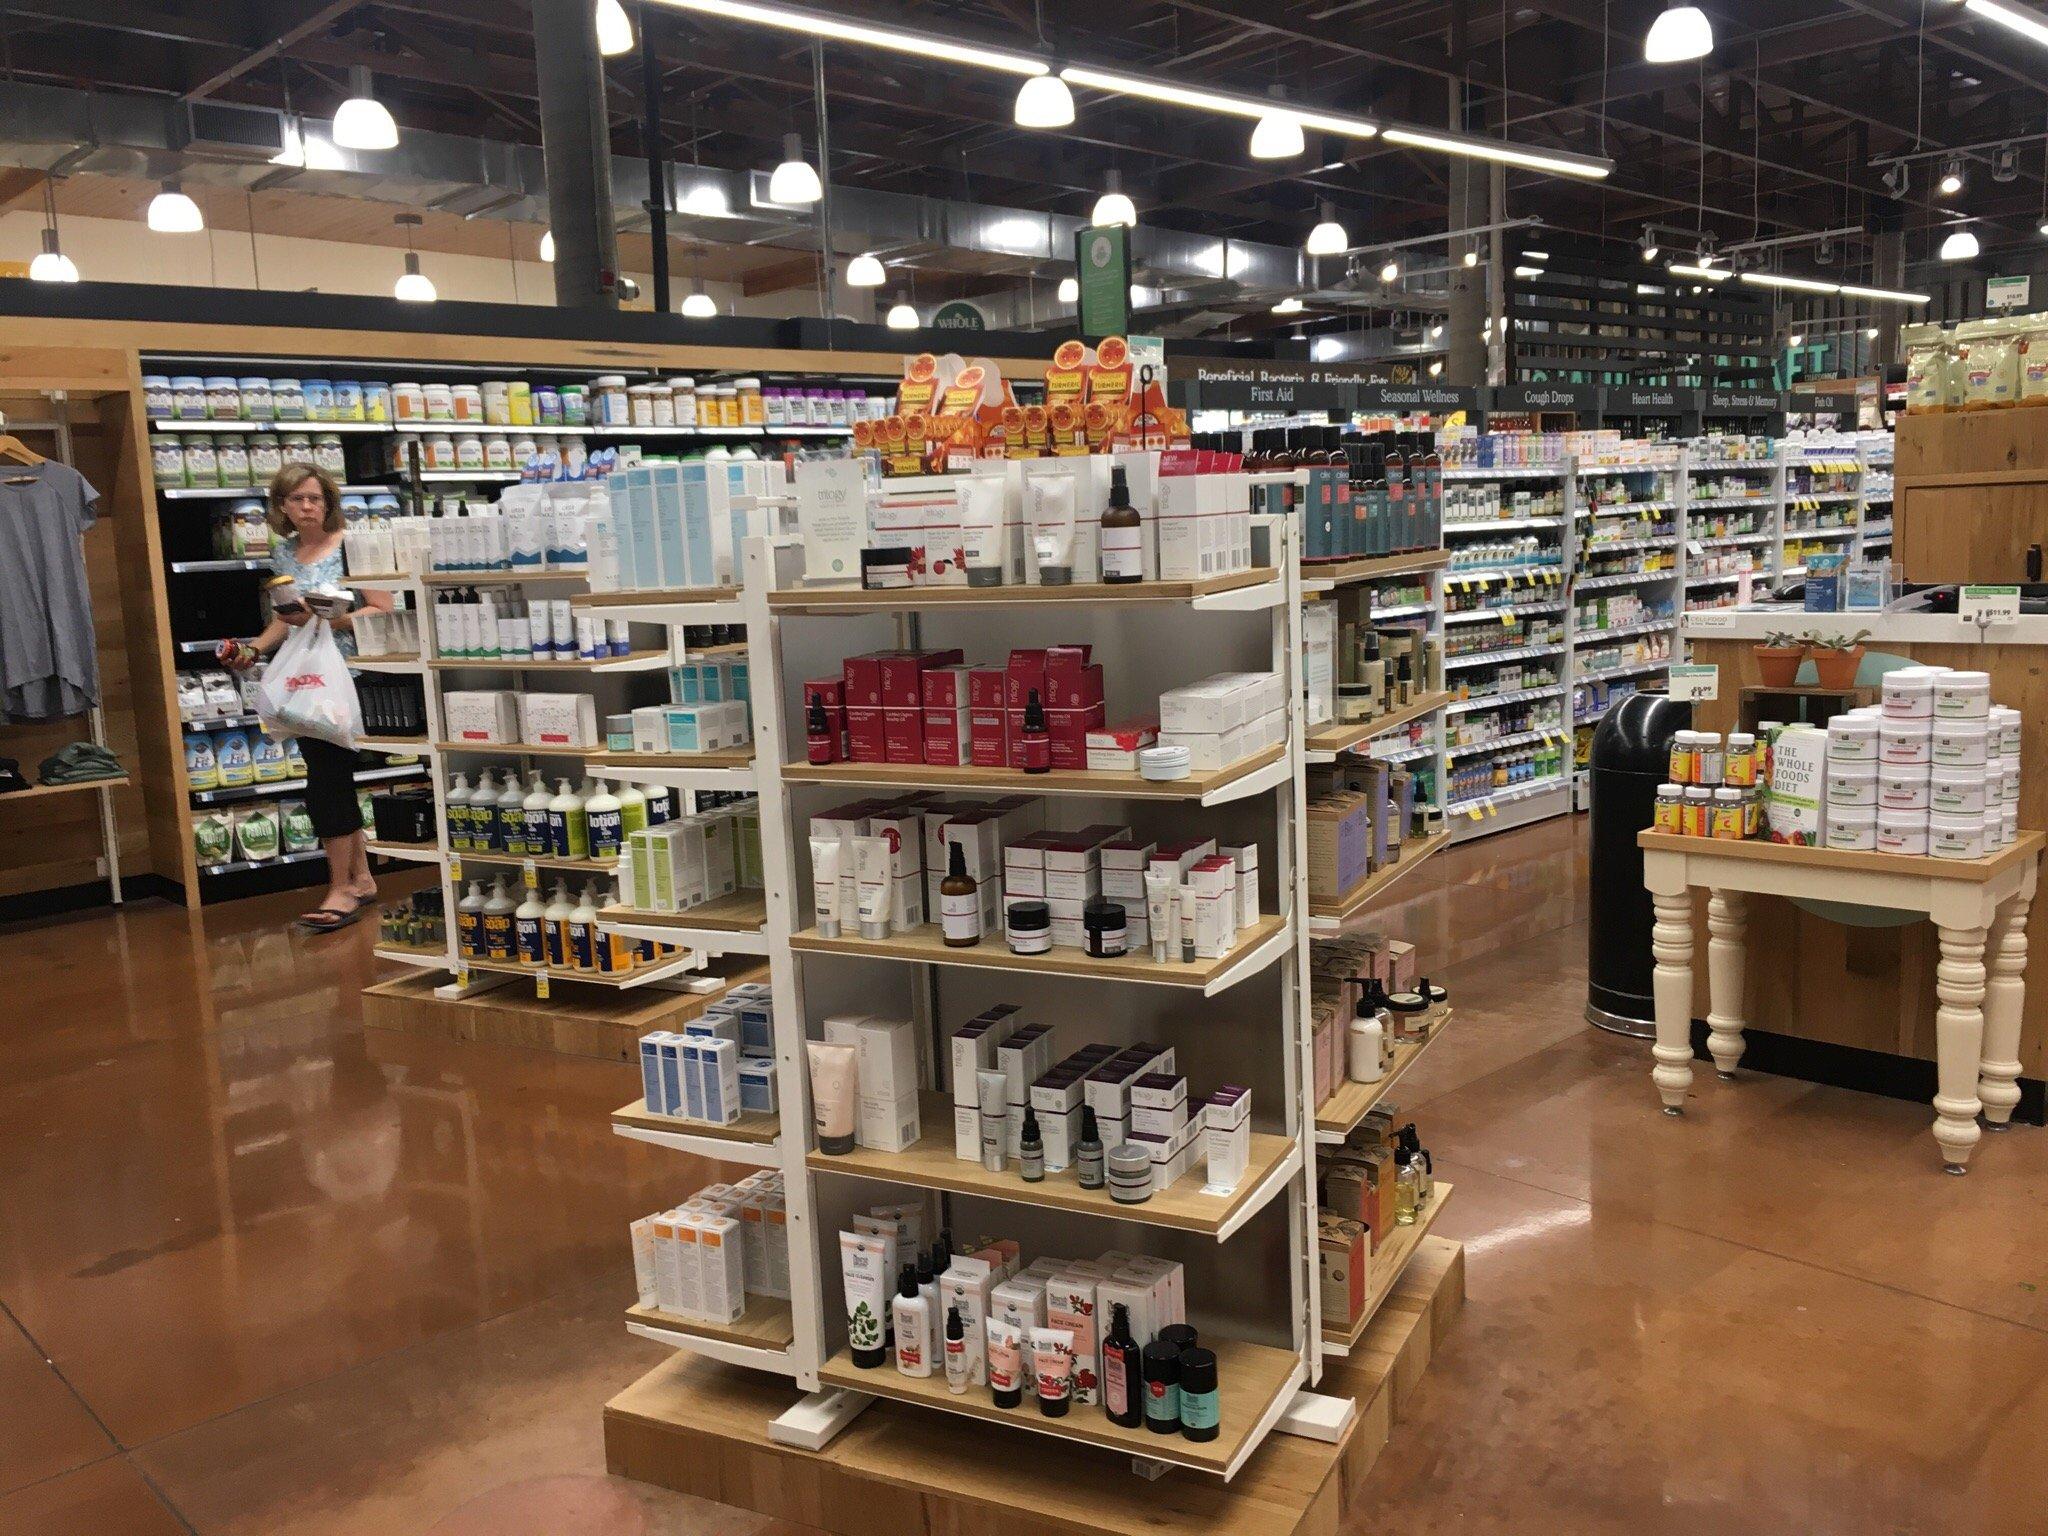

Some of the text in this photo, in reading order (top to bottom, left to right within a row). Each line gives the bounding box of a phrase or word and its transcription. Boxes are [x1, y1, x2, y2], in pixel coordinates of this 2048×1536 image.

[1251, 387, 1294, 402] First Aid
[1380, 389, 1460, 403] Seasonal Wellness
[1524, 391, 1575, 406] Cough Drops
[1632, 393, 1674, 405] Heart Health
[1713, 394, 1731, 408] Sleep,
[1755, 395, 1778, 409] Memory
[848, 666, 857, 690] trilogy
[884, 666, 893, 691] trilogy
[1010, 678, 1019, 703] trilogy
[1049, 678, 1058, 703] trilogy
[1778, 746, 1797, 758] THE
[1777, 757, 1815, 773] WHOLE
[1776, 769, 1810, 784] FOODS
[1775, 780, 1798, 793] DIET
[589, 812, 620, 828] lotion
